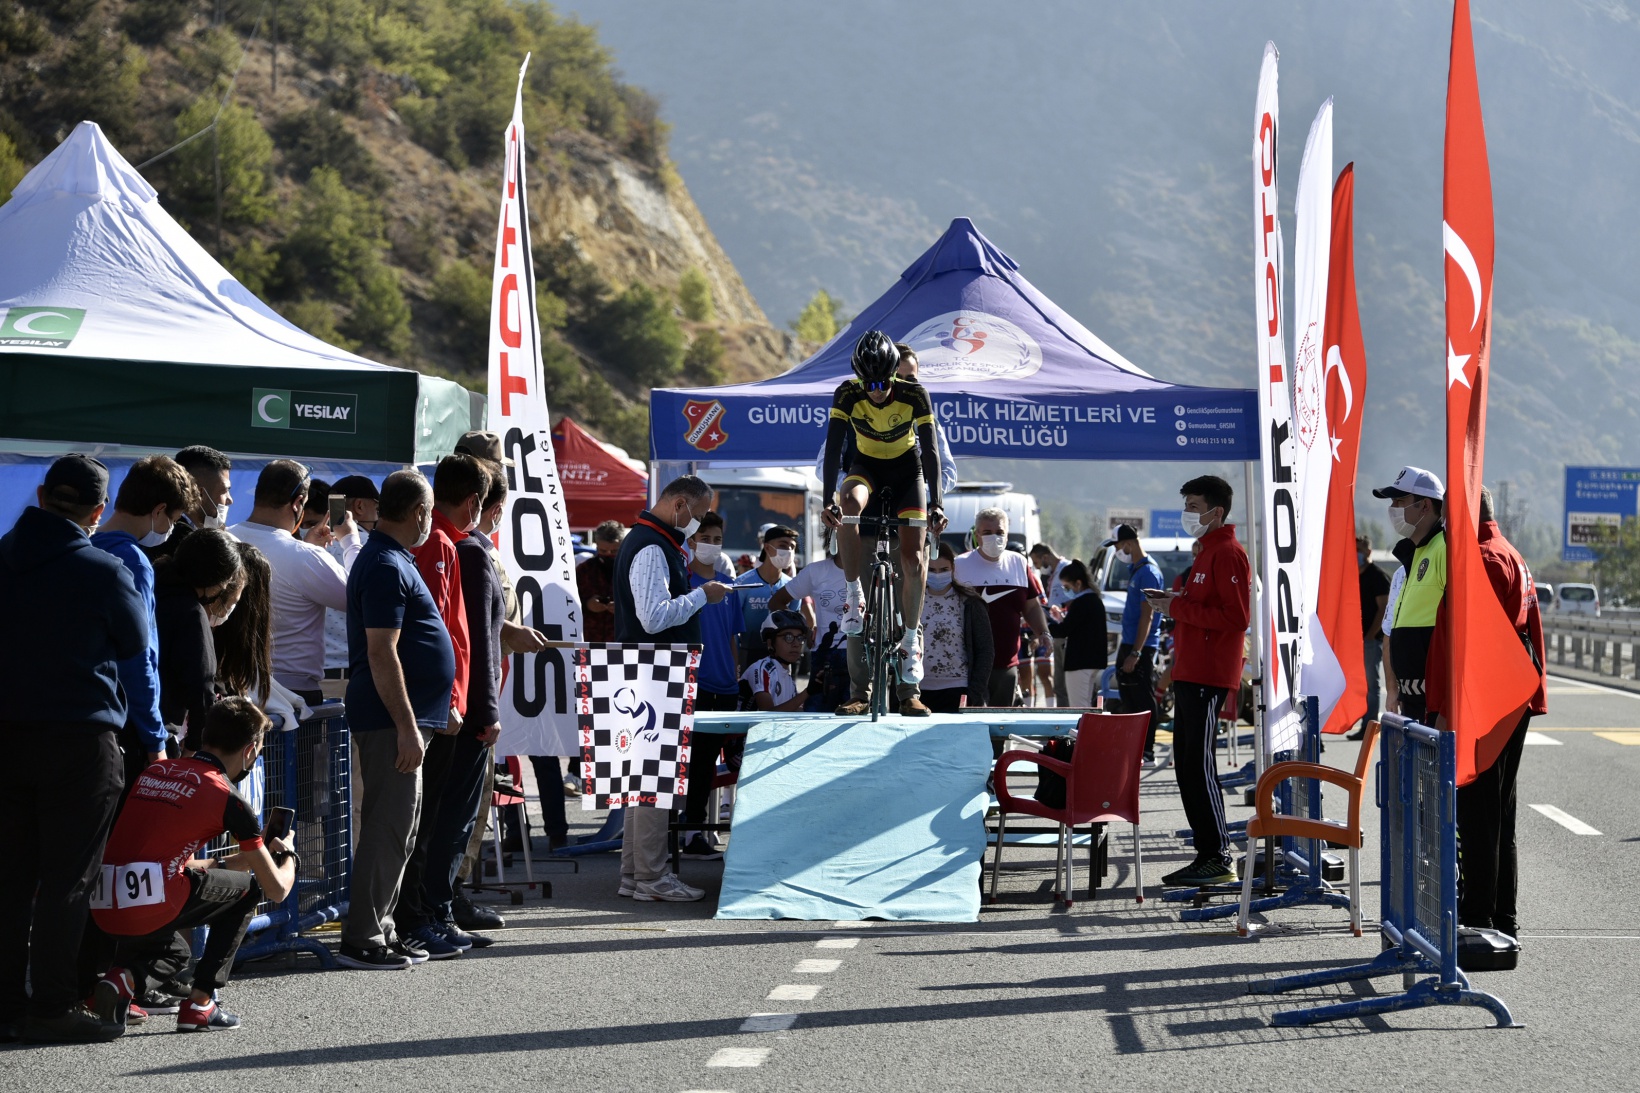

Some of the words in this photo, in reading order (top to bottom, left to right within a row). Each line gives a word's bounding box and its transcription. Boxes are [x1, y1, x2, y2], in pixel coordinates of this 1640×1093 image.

[500, 125, 528, 416] TOTO
[1260, 112, 1283, 406] TOTO
[690, 405, 720, 443] GÜMÜŞHANE
[943, 421, 1068, 447] ÜDÜRLÜĞÜ
[995, 400, 1121, 423] HİZMETLERİ
[1127, 407, 1156, 423] VE
[539, 429, 571, 581] BAŞKANLIĞI
[504, 427, 567, 717] SPOR
[579, 648, 589, 715] SALCANO
[685, 649, 699, 716] SALCANO
[136, 787, 160, 797] CYCLING
[159, 790, 180, 801] TEAM
[583, 725, 593, 796] SALCANO
[677, 725, 691, 796] SALCANO
[125, 868, 153, 900] 91
